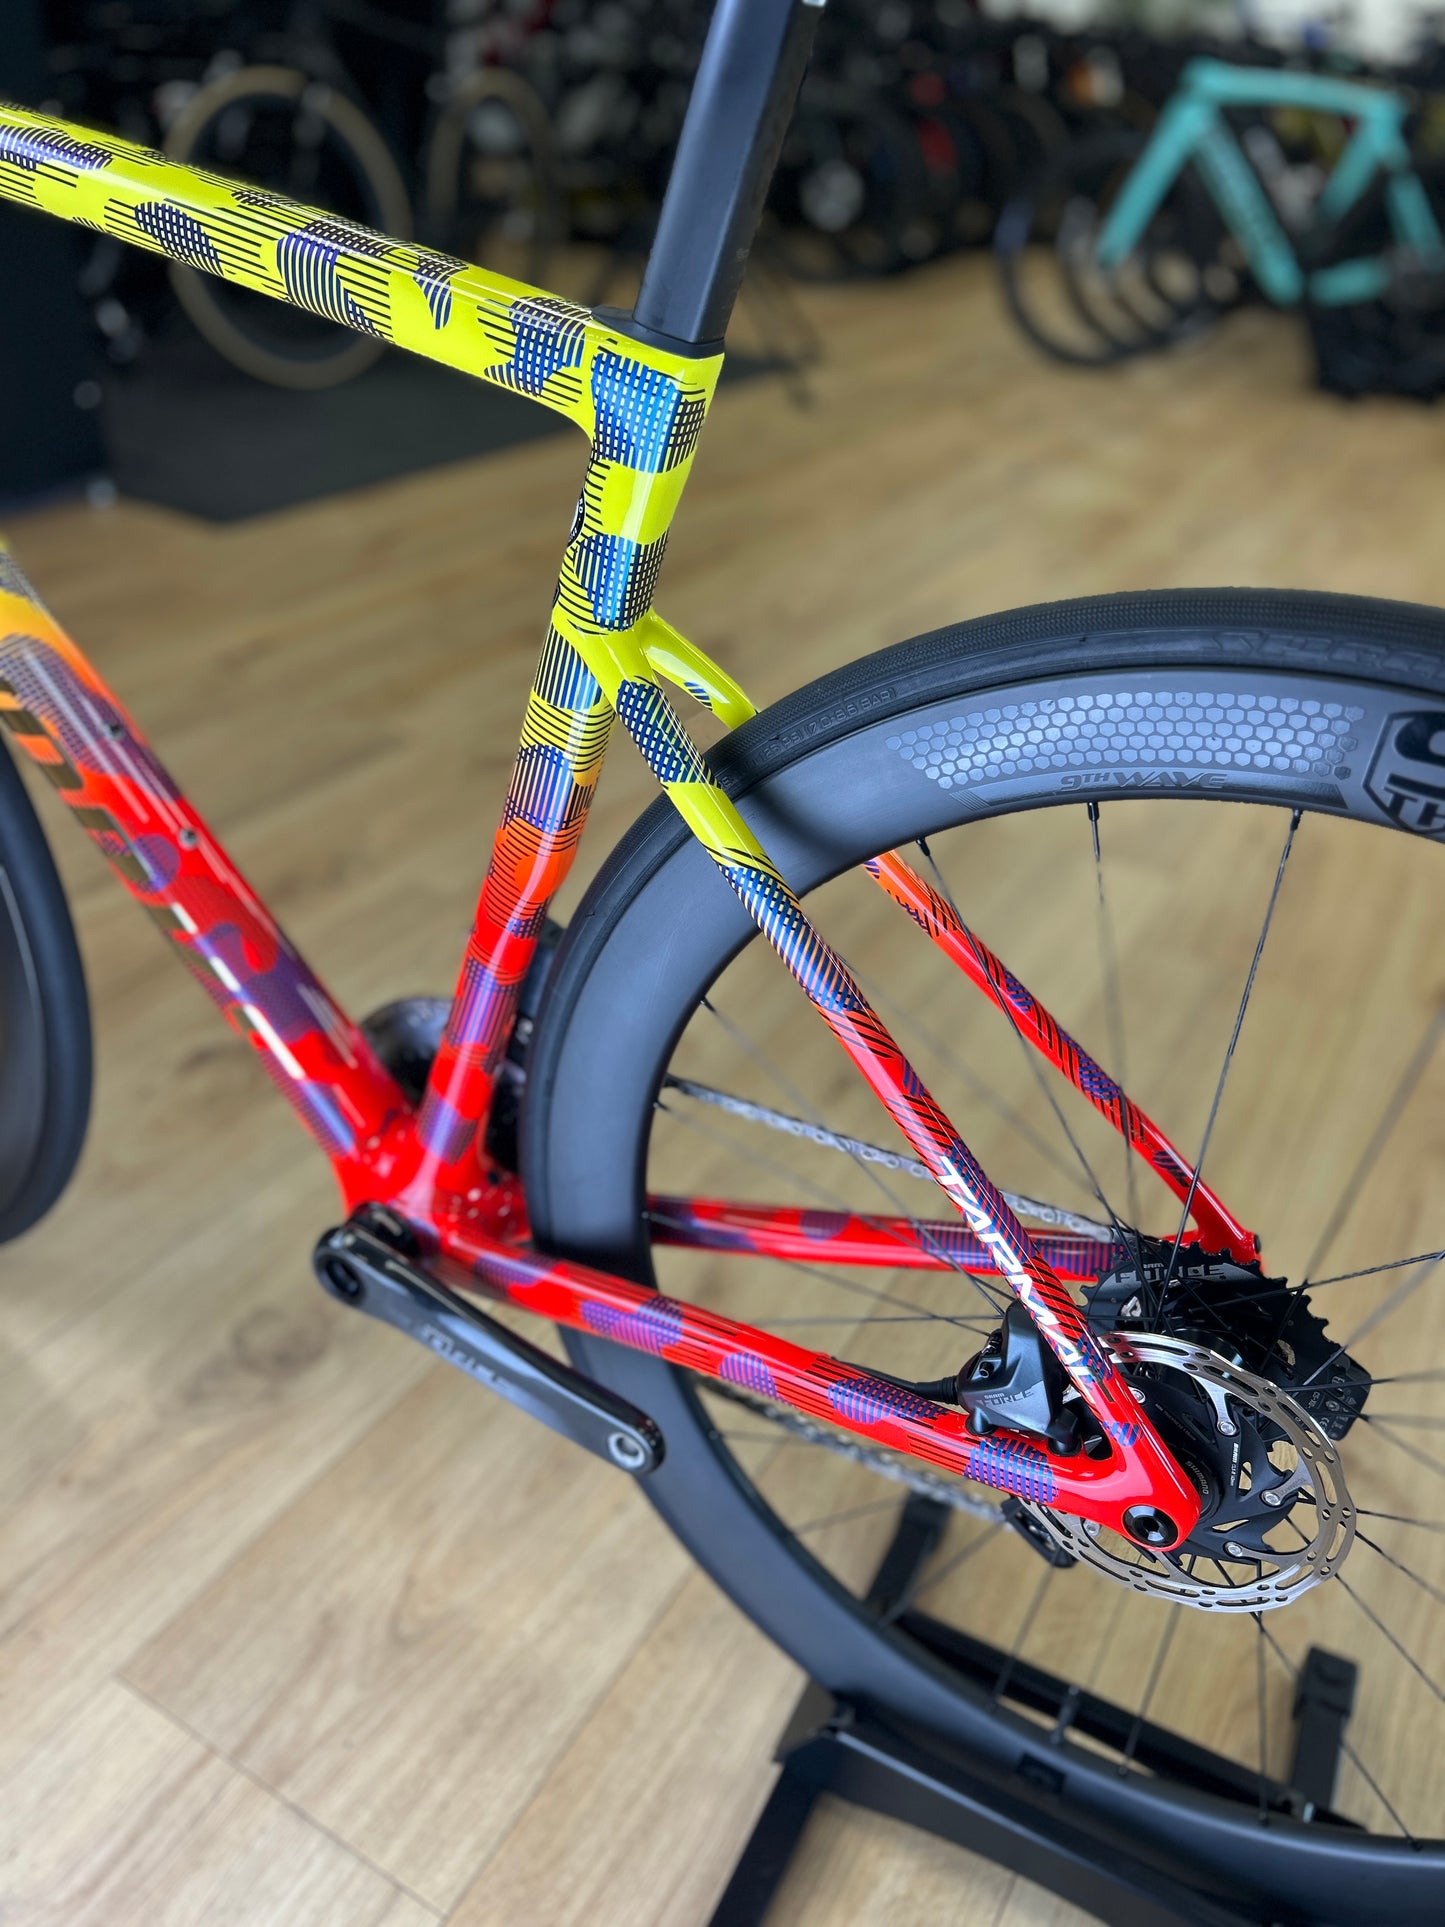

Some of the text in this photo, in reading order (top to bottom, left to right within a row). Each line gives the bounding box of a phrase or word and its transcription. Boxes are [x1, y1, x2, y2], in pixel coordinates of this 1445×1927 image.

[1060, 771, 1228, 792] 9TH WAVE
[982, 1390, 1034, 1406] FORCE
[1185, 1460, 1209, 1495] SHIMANO
